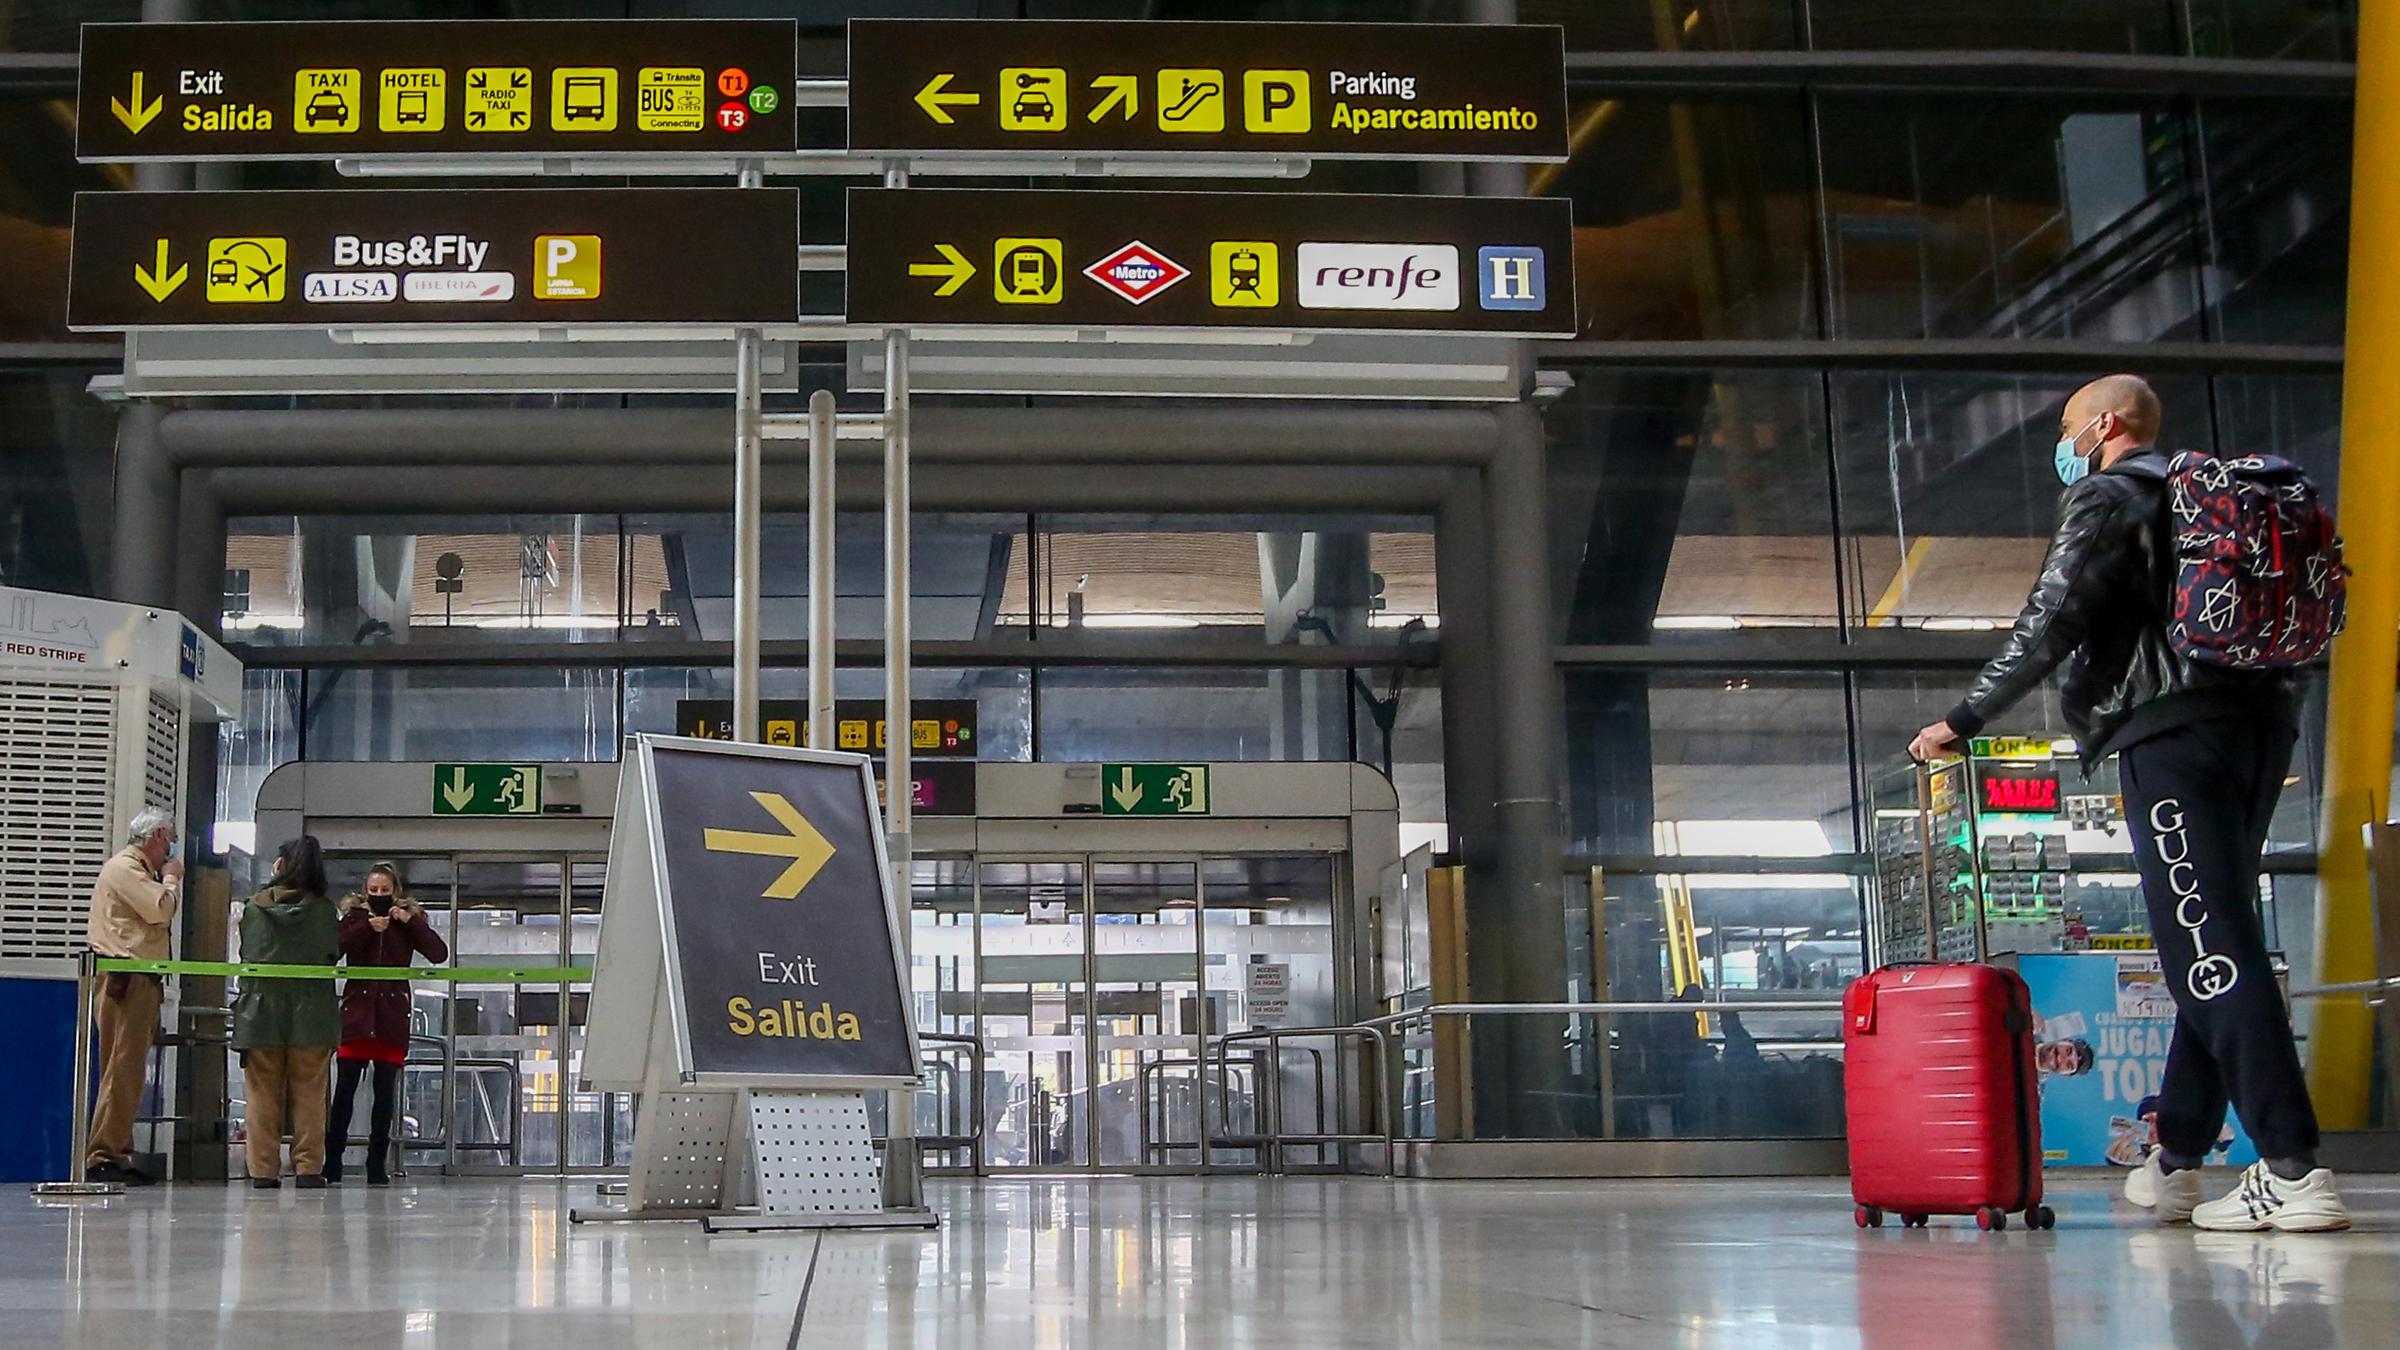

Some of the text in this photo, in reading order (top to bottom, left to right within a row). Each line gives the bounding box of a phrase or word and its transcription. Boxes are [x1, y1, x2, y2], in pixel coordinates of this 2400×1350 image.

[180, 70, 224, 95] Exit
[308, 73, 348, 87] TAXI
[385, 74, 441, 88] HOTEL
[723, 76, 744, 91] T1
[1329, 71, 1416, 99] Parking
[481, 89, 517, 99] RADIO
[641, 88, 674, 112] BUS
[751, 93, 776, 108] T2
[1262, 81, 1295, 123] P
[487, 101, 511, 110] TAXI
[182, 103, 273, 132] Salida
[650, 119, 701, 128] Connecting
[720, 110, 745, 127] T3
[1331, 102, 1538, 134] Aparcamiento
[334, 235, 489, 272] Bus&Fly
[547, 239, 577, 277] P
[1115, 266, 1158, 279] Metro
[1315, 255, 1441, 299] renfe
[1489, 257, 1535, 299] H
[308, 278, 391, 297] ALSA
[415, 280, 478, 290] IBERIA
[7, 643, 35, 655] RED
[39, 647, 86, 663] STRIPE
[2150, 798, 2208, 960] GUCCI
[2094, 938, 2143, 950] ONCE
[758, 952, 819, 986] Exit
[727, 996, 862, 1041] Salida
